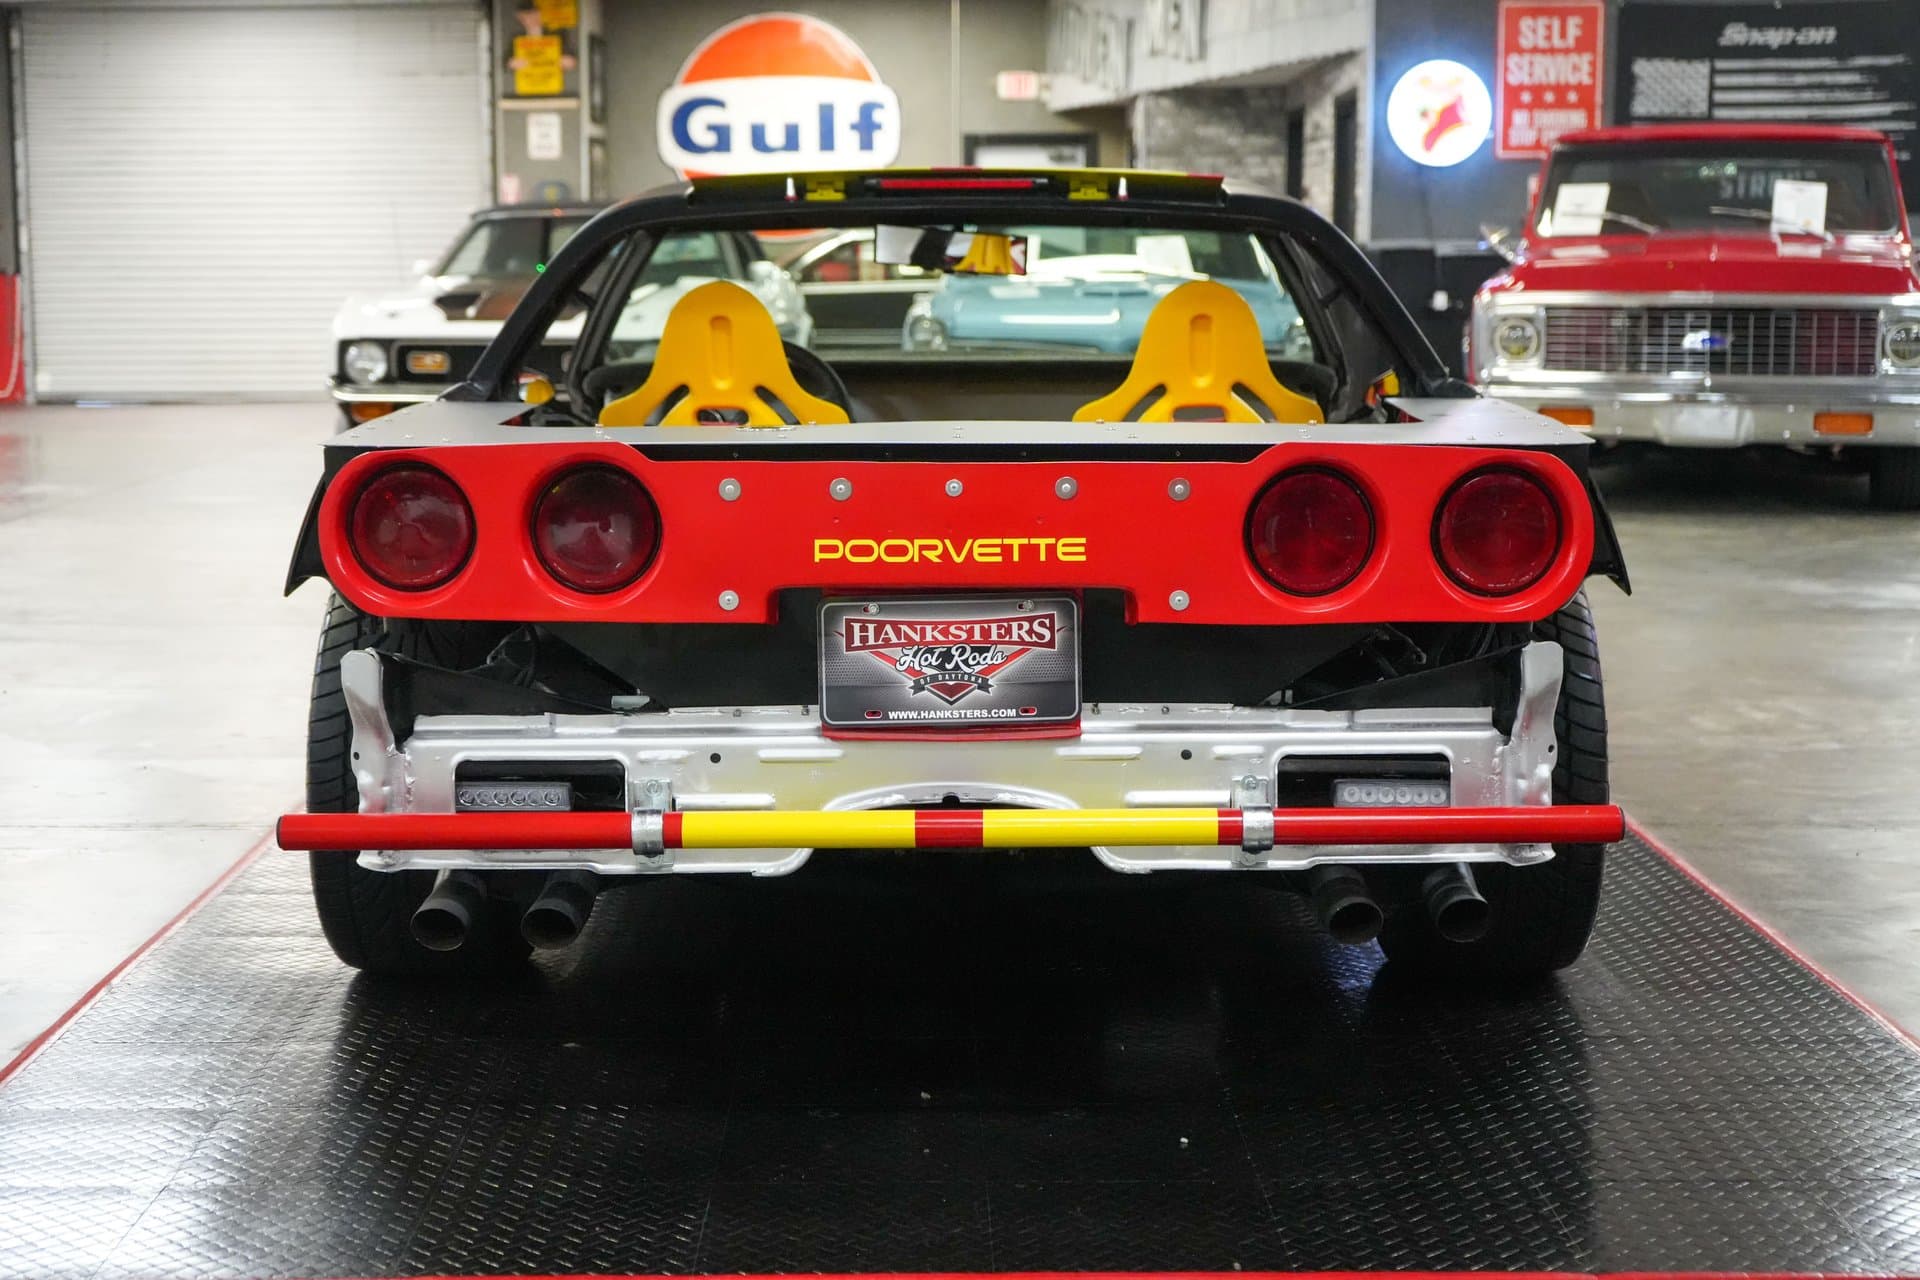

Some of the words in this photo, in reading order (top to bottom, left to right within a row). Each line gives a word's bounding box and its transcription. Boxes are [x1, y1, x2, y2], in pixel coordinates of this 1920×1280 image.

[1519, 15, 1583, 49] SELF
[1717, 22, 1837, 49] Snap-on
[1507, 52, 1593, 86] SERVICE
[672, 97, 884, 154] Gulf
[814, 537, 1086, 563] POORVETTE
[850, 618, 1051, 647] HANKSTERS
[895, 644, 948, 671] Hot
[945, 643, 1007, 673] Rods
[938, 673, 982, 683] DAYTONA
[888, 709, 1016, 719] WWW.HANKSTERS.COM
